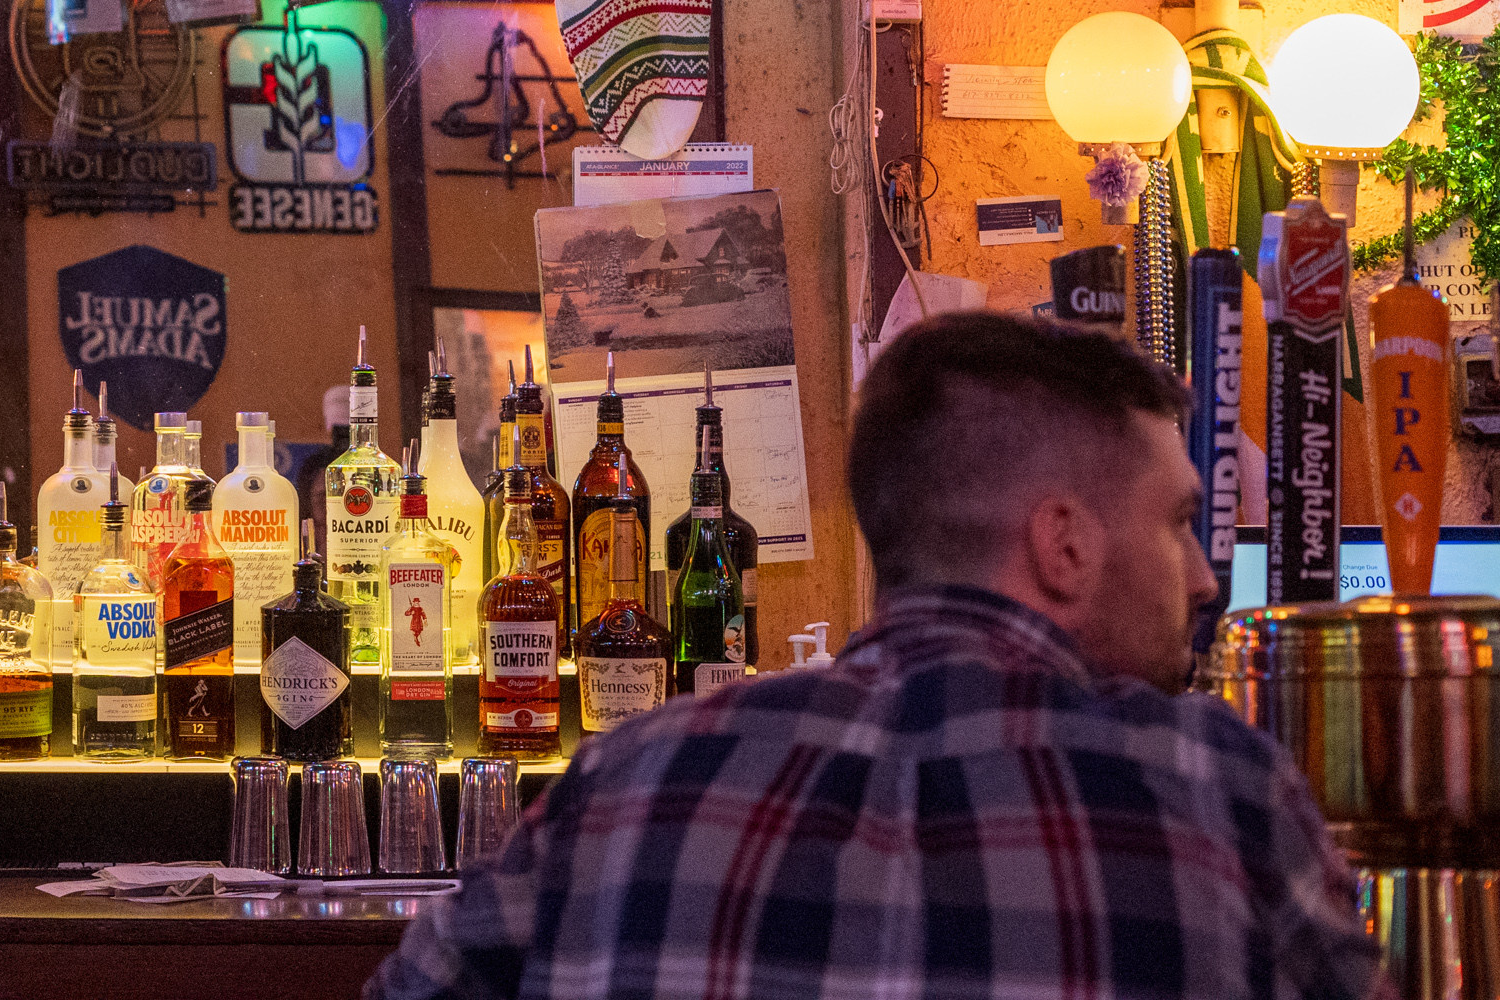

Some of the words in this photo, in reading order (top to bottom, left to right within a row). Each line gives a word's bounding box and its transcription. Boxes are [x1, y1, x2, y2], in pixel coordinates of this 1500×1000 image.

[639, 161, 690, 172] JANUARY
[726, 162, 744, 170] 2022
[1214, 302, 1243, 450] LIGHT
[1393, 371, 1423, 473] IPA
[1211, 454, 1239, 563] BUD
[222, 509, 287, 526] ABSOLUT
[331, 516, 390, 534] BACARDÍ
[220, 525, 289, 542] MANDRIN
[390, 568, 443, 586] BEEFEATER
[1340, 574, 1386, 590] $0.00
[107, 621, 156, 639] VODKA
[167, 631, 198, 647] BLACK
[198, 620, 228, 635] LABEL
[489, 633, 553, 650] SOUTHERN
[494, 651, 550, 667] COMFORT
[261, 677, 338, 690] HENDRICK'S
[507, 678, 538, 688] Original
[591, 679, 653, 697] Hennessy
[282, 694, 308, 703] GIN
[18, 705, 35, 713] RYE
[192, 724, 204, 734] 12
